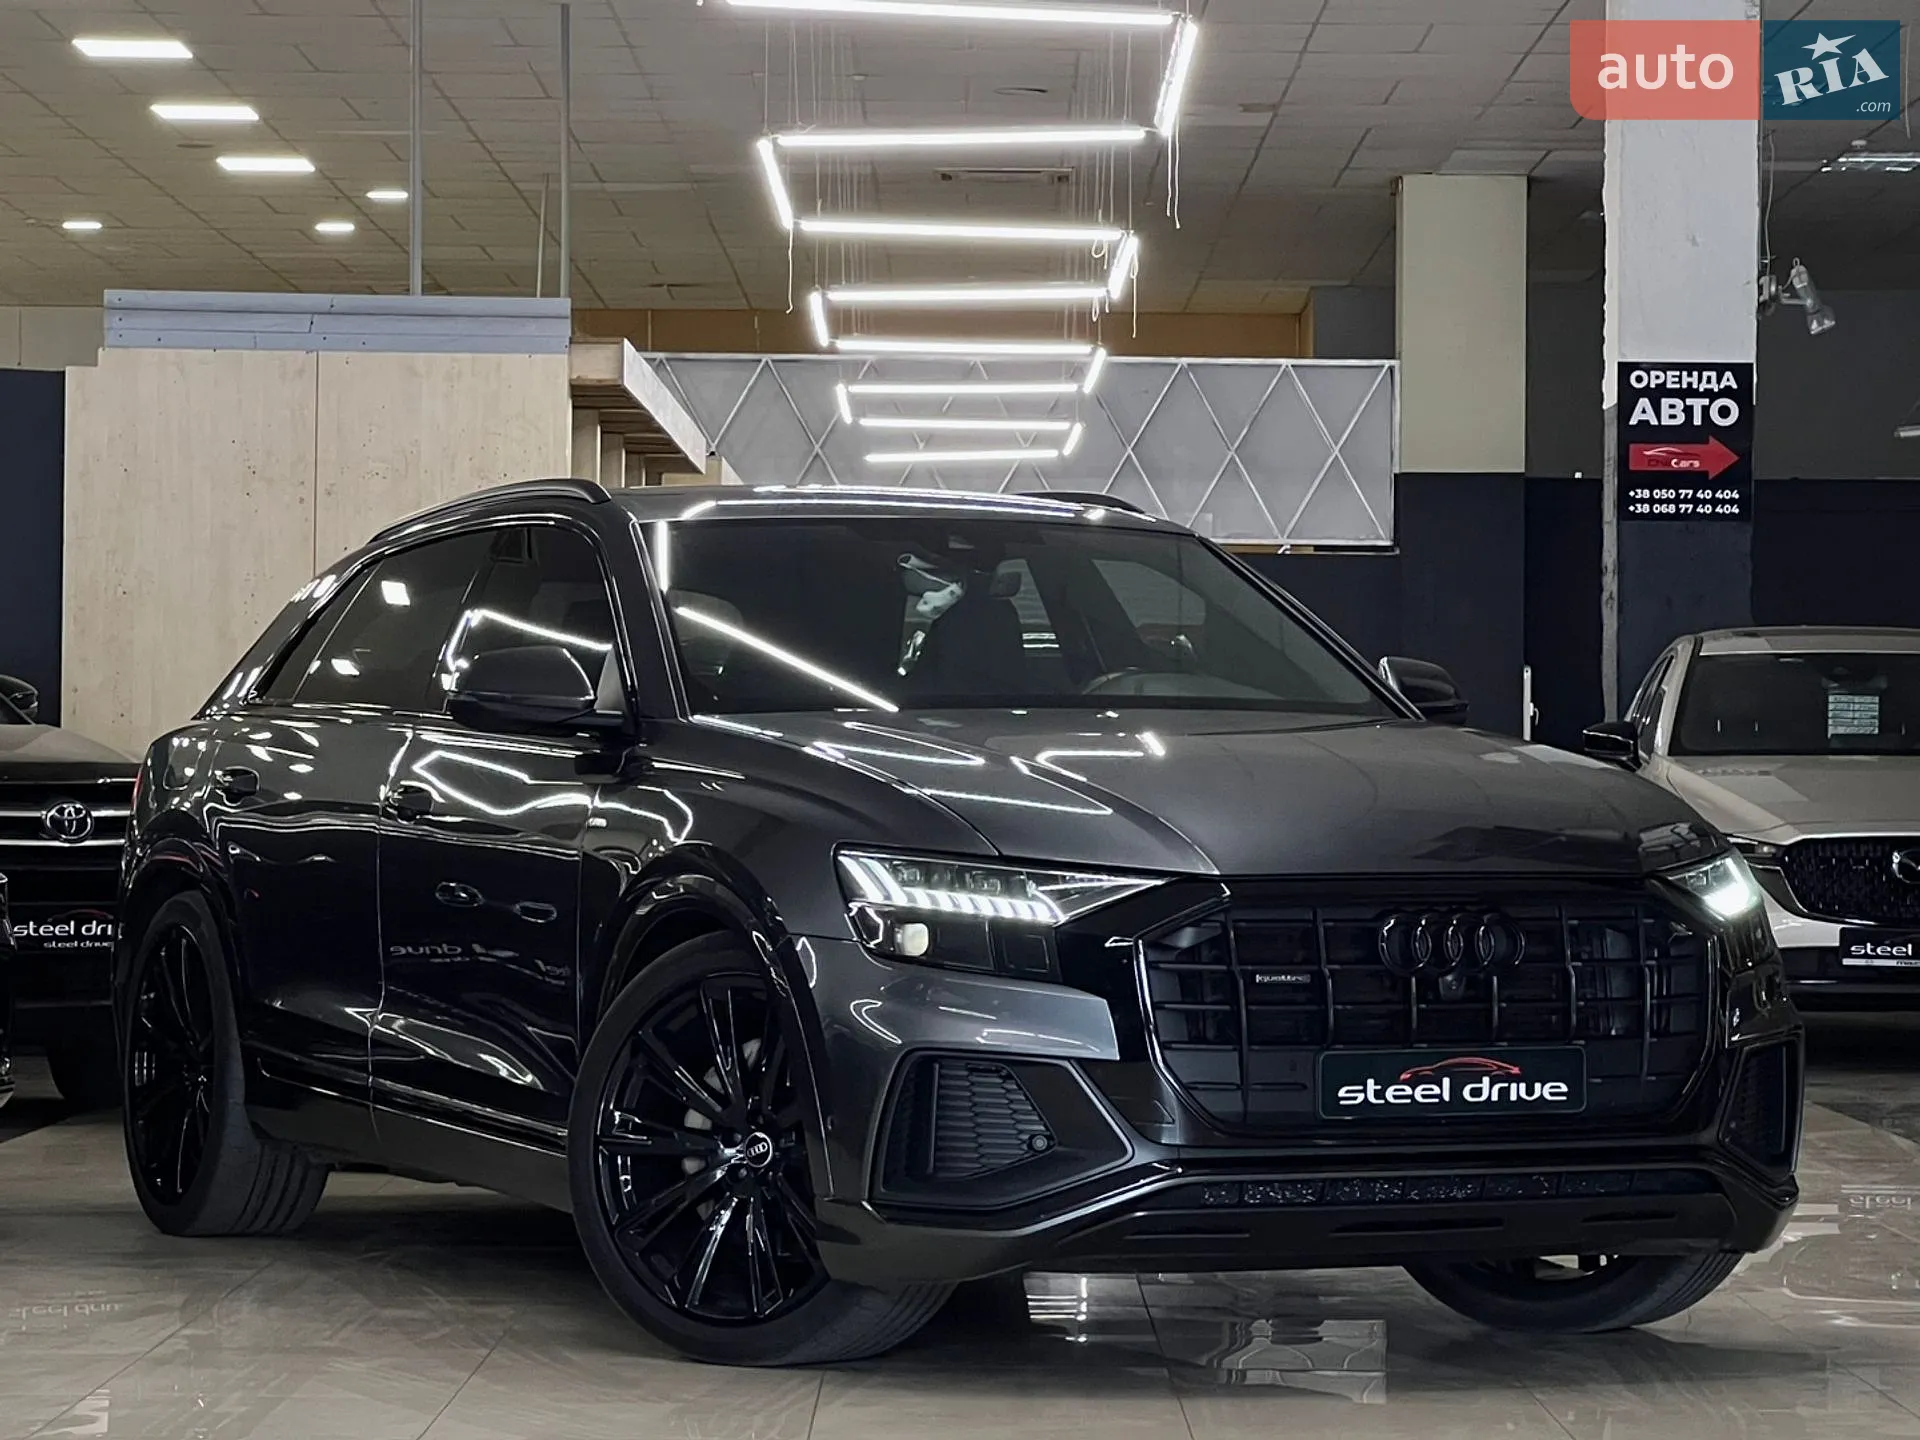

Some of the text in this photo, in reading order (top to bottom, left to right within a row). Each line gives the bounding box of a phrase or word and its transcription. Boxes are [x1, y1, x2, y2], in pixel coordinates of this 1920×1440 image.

[1629, 370, 1738, 392] ОРЕНДА
[1628, 397, 1740, 427] АВТО
[1628, 489, 1740, 499] +38 050 77 40 404
[1628, 504, 1740, 514] +38 068 77 40 404
[13, 920, 112, 936] steel dri
[1850, 942, 1912, 956] steel
[1337, 1075, 1569, 1105] steel drive
